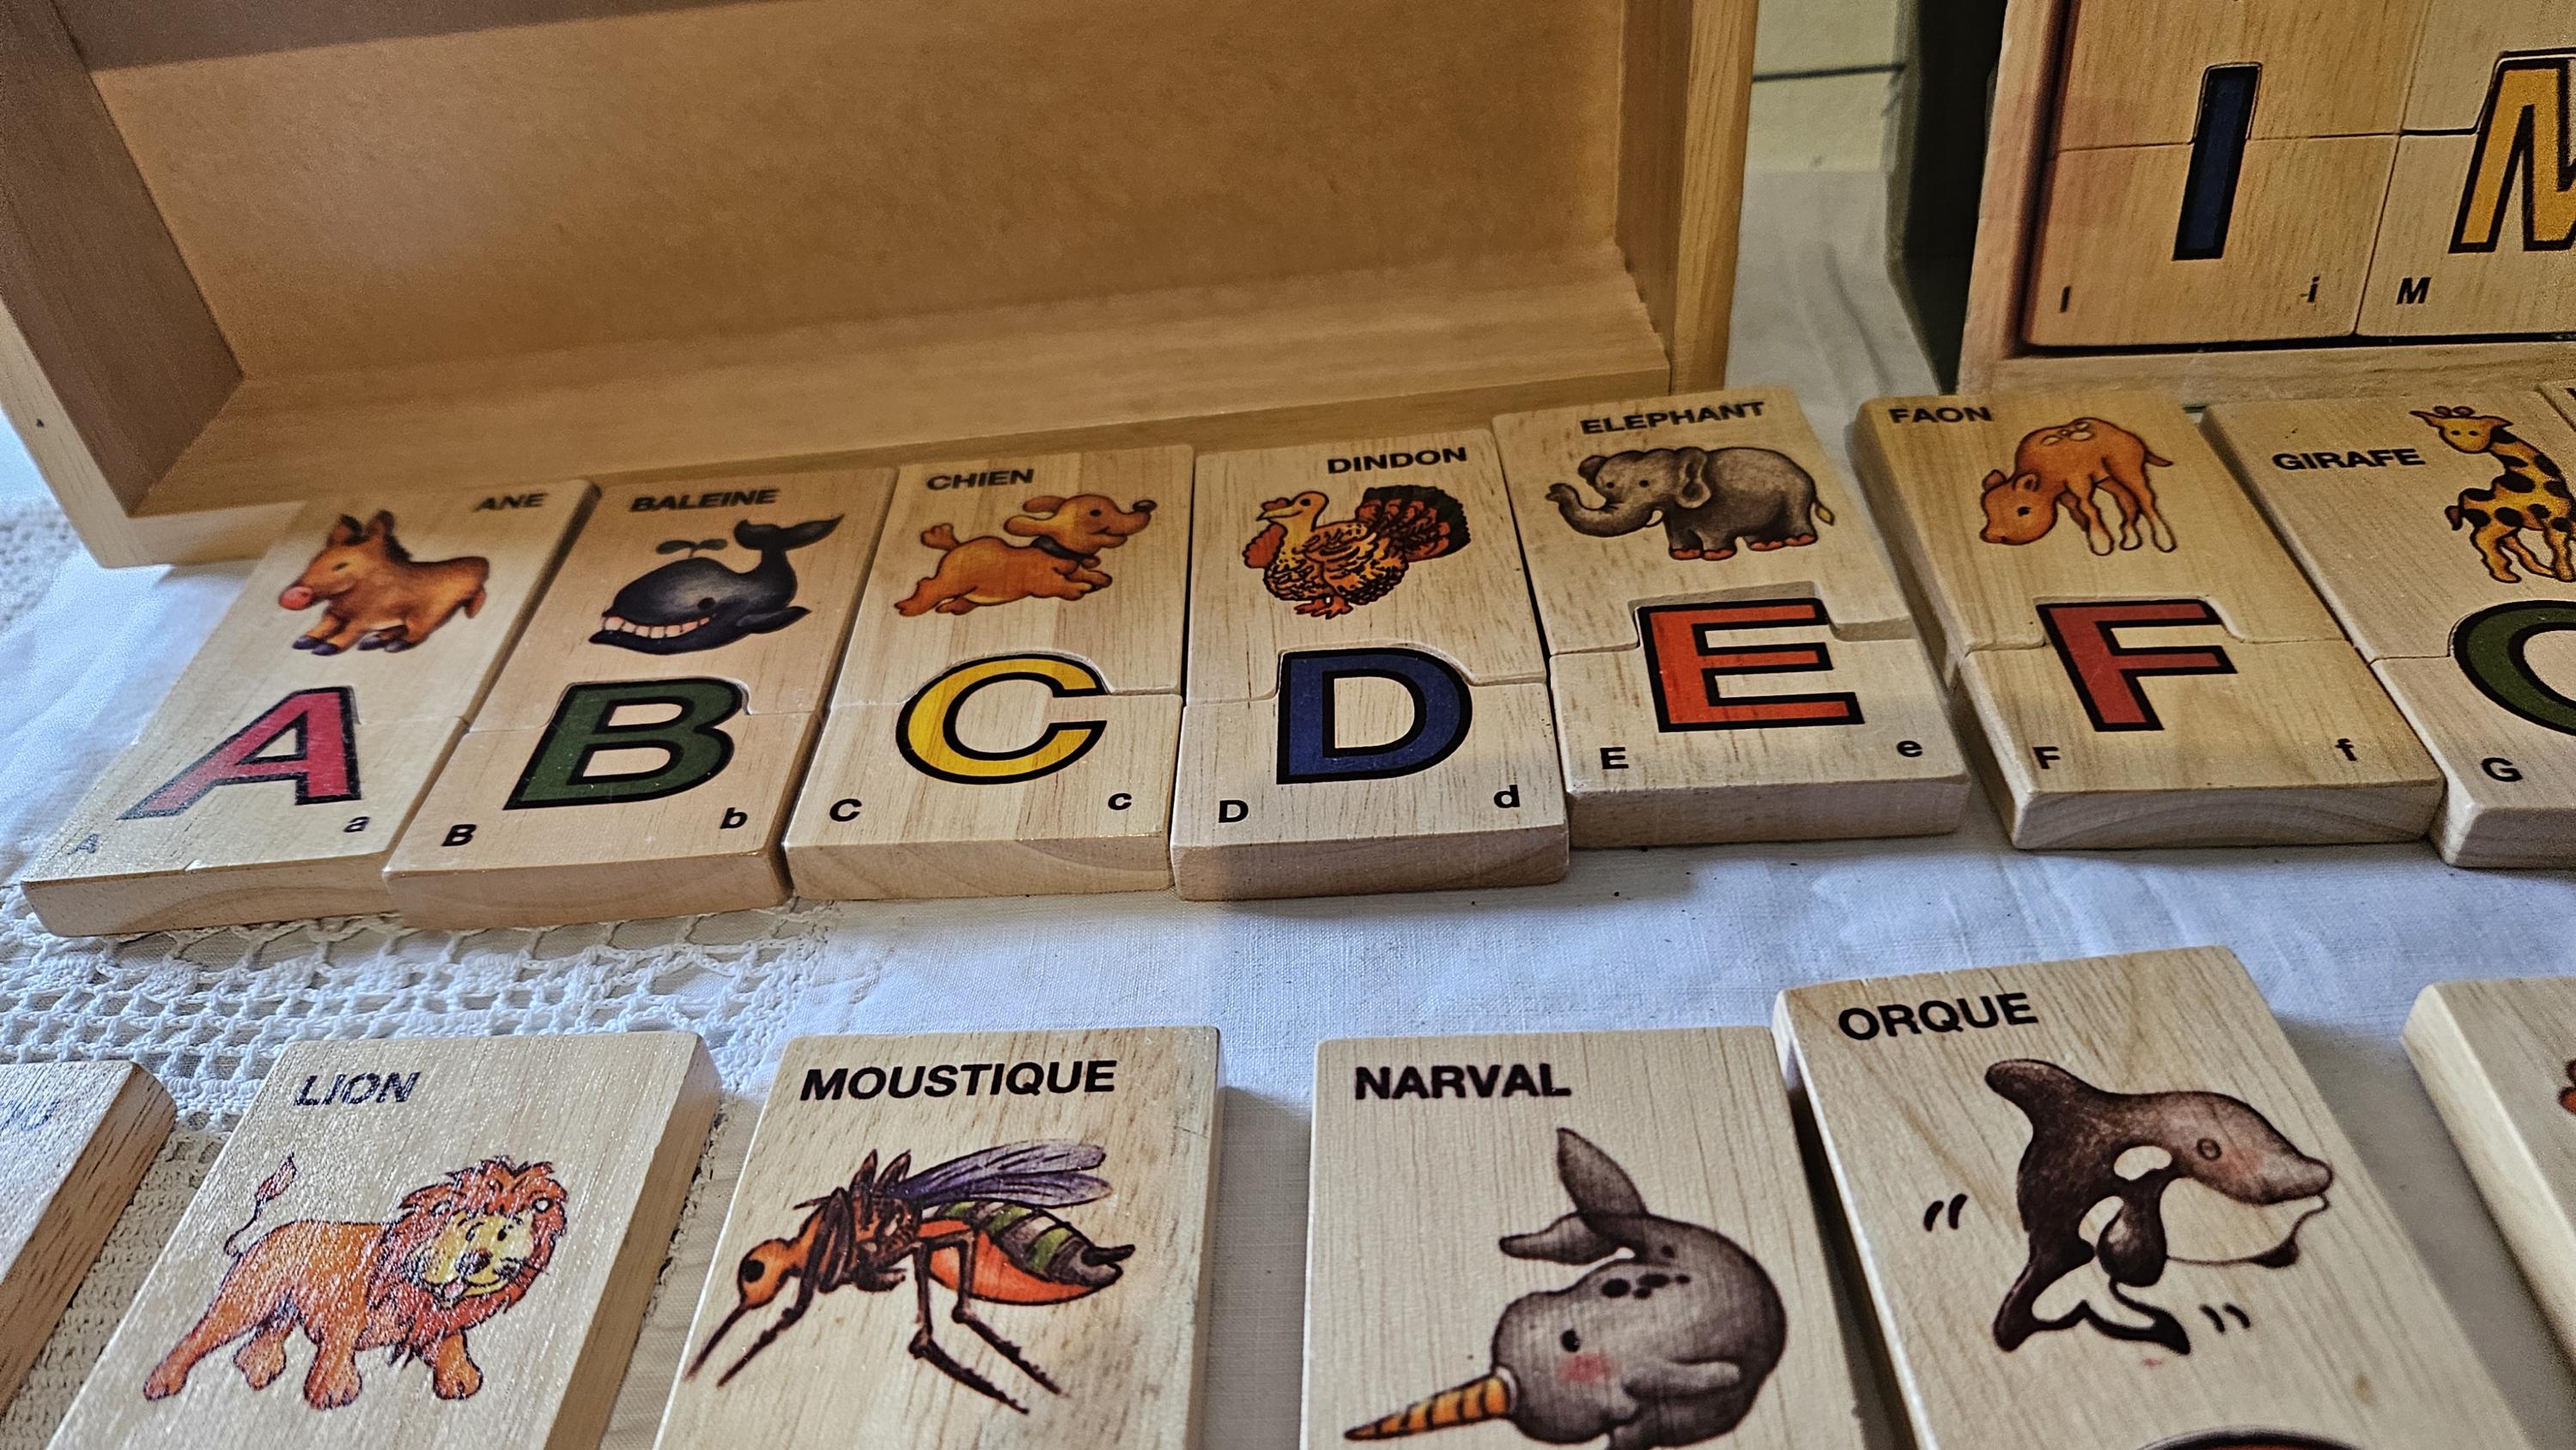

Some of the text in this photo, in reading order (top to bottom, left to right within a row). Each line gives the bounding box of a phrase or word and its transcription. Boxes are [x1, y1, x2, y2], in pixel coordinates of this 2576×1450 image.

[2172, 63, 2262, 261] I
[2059, 285, 2071, 312] I
[2307, 276, 2320, 303] i
[2396, 276, 2432, 305] M
[1579, 400, 1765, 435] ELEPHANT
[1887, 406, 1993, 424] FAON
[1327, 446, 1467, 475] DINDON
[2271, 447, 2427, 470] GIRAFE
[926, 468, 1035, 491] CHIEN
[473, 492, 548, 513] ANE
[629, 488, 780, 513] BALEINE
[1634, 598, 1865, 732] E
[2036, 599, 2238, 731] F
[896, 653, 1107, 785] C
[1276, 647, 1473, 785] D
[116, 686, 361, 821] A
[502, 679, 746, 810] B
[1599, 746, 1630, 770] E
[1896, 740, 1923, 758] e
[2032, 746, 2061, 770] F
[2335, 737, 2358, 762] f
[2480, 756, 2524, 783] G
[829, 798, 862, 822] C
[1493, 784, 1521, 809] d
[719, 807, 748, 830] b
[1218, 799, 1249, 823] D
[343, 816, 371, 834] a
[440, 823, 477, 847] B
[1838, 992, 2039, 1041] ORQUE
[293, 1071, 422, 1107] LION
[799, 1059, 1118, 1101] MOUSTIQUE
[1354, 1062, 1572, 1101] NARVAL
